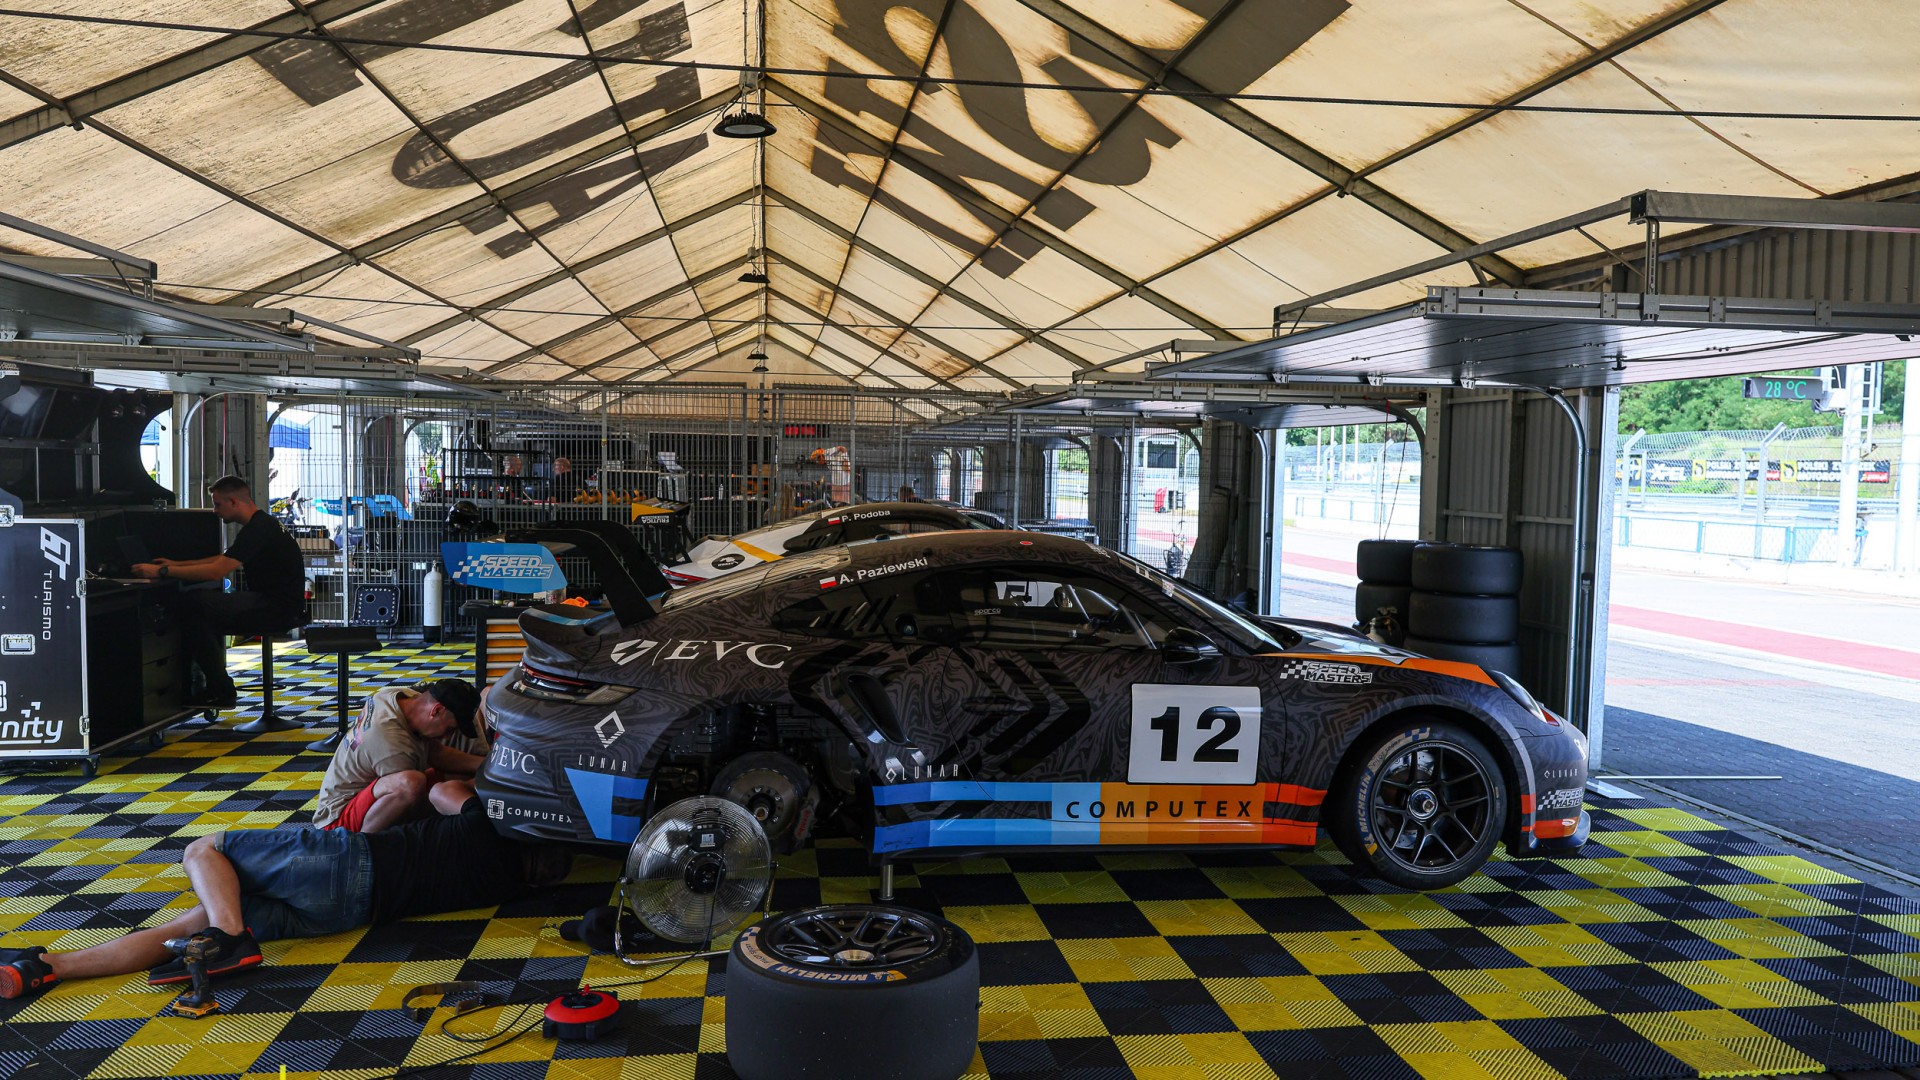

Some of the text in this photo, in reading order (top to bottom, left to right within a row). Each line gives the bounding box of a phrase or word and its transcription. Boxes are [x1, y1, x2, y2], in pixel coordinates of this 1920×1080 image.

[1765, 381, 1807, 399] 28 °C
[1798, 461, 1828, 470] POLSKI
[854, 510, 891, 520] Podoba
[485, 556, 541, 567] SPEED
[839, 557, 928, 584] A. Paziewski
[480, 567, 551, 577] MASTERS
[42, 569, 53, 641] TURISMO
[664, 639, 793, 669] EVC
[1306, 671, 1371, 684] MASTERS
[0, 717, 63, 744] nity
[1150, 706, 1242, 763] 12
[498, 746, 536, 775] EVC
[578, 754, 627, 772] LUNAR
[901, 764, 960, 780] LUNAR
[1066, 801, 1252, 819] COMPUTEX
[1357, 774, 1371, 833] MICHELIN
[776, 964, 868, 982] MICHELIN
